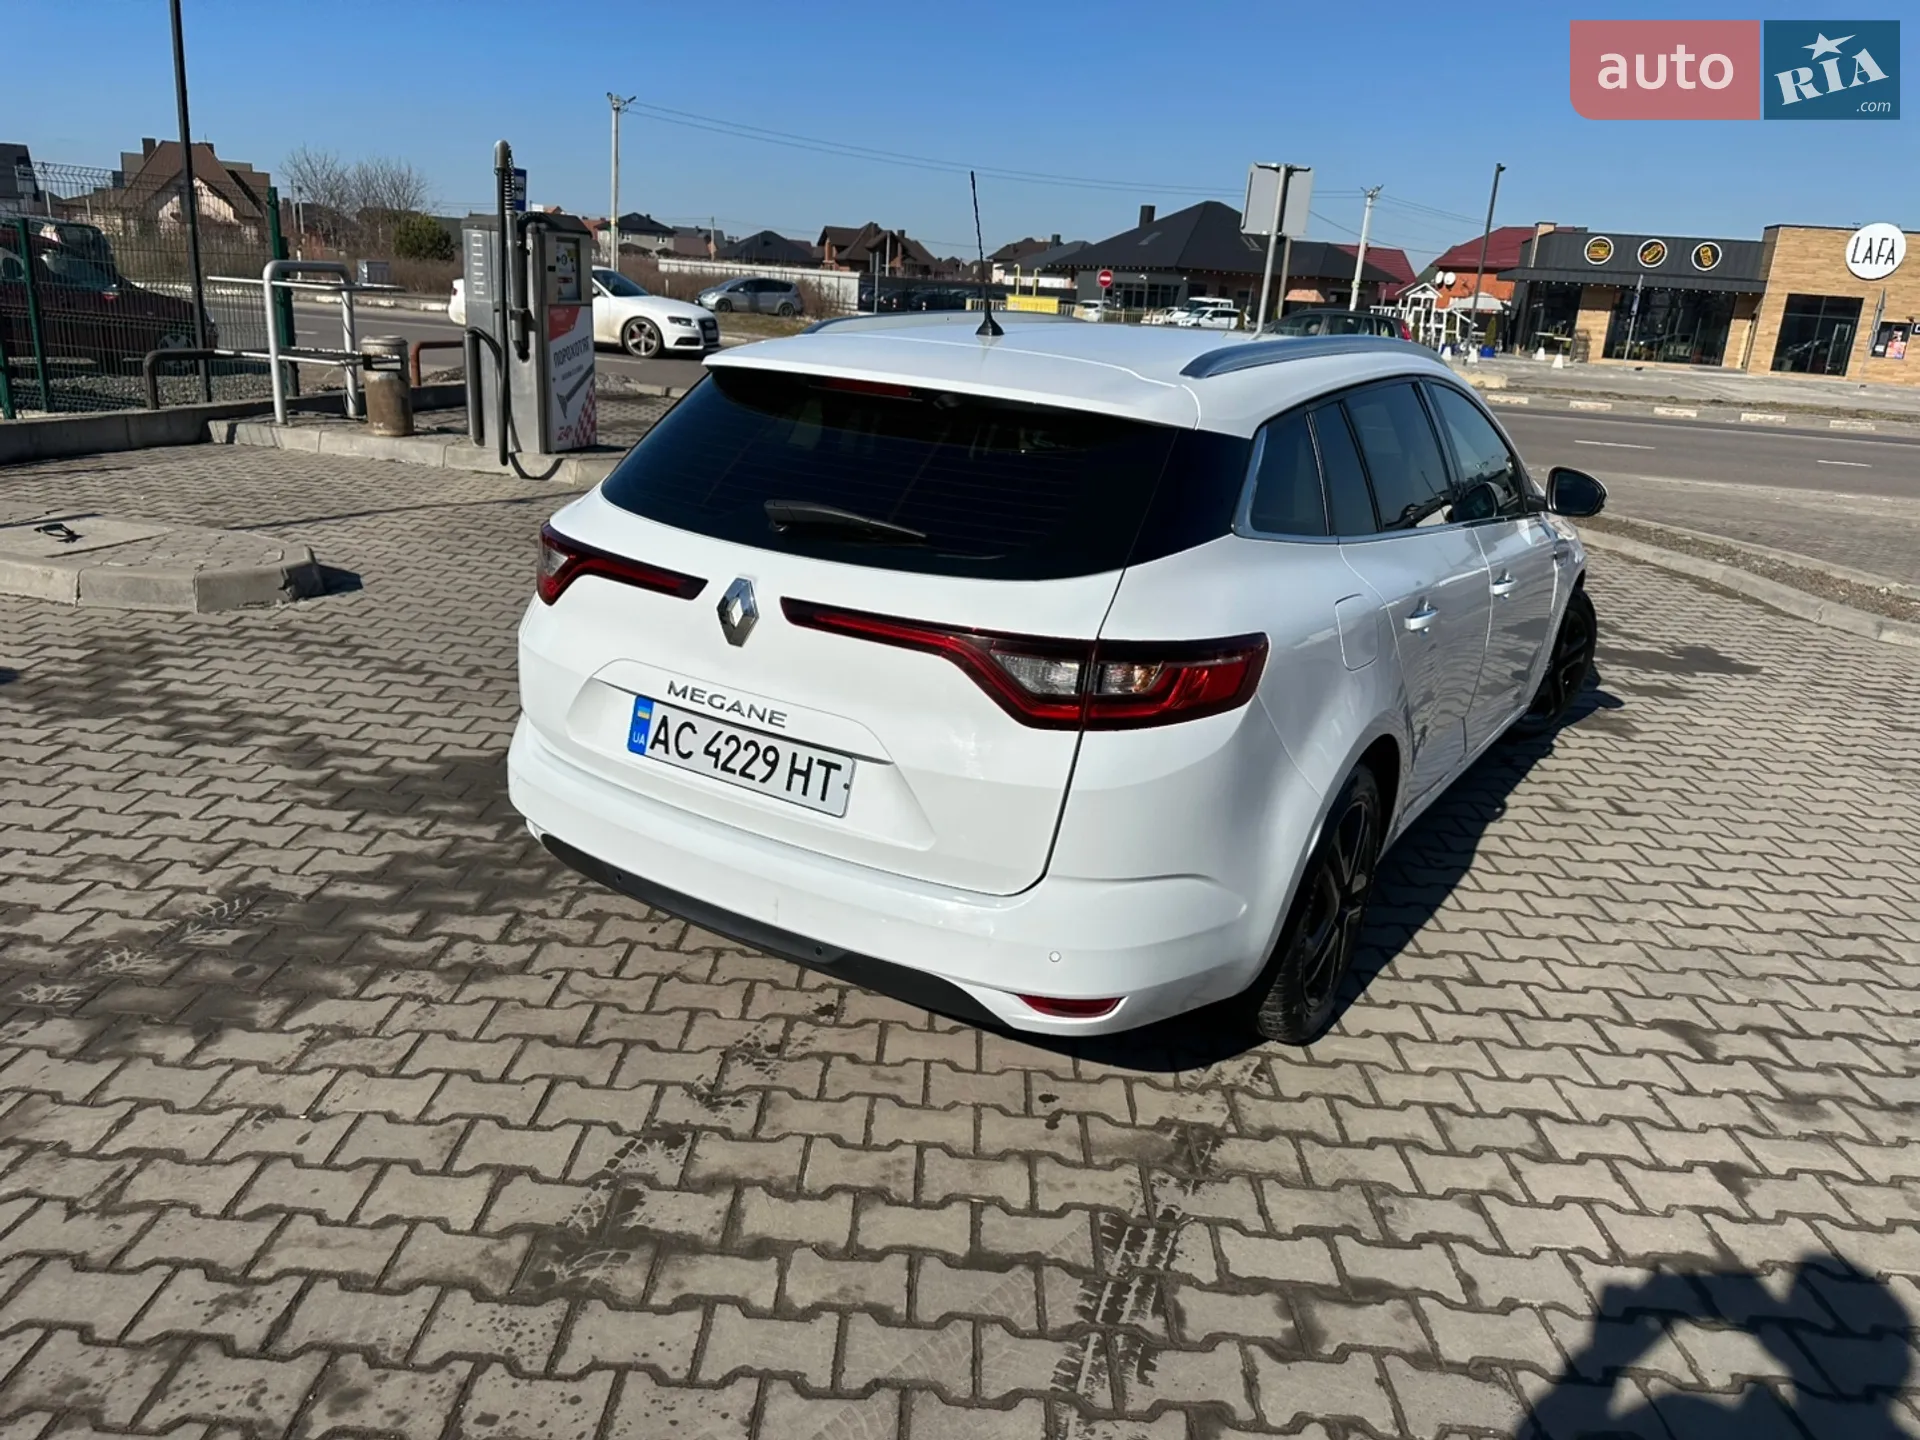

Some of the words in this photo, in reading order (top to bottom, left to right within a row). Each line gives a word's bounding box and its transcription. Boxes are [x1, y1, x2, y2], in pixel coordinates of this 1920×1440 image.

[1851, 236, 1895, 266] LAFA
[667, 680, 788, 728] MEGANE
[632, 732, 645, 746] UA
[649, 714, 698, 760] AC
[703, 730, 780, 784] 4229
[785, 752, 842, 802] HT
